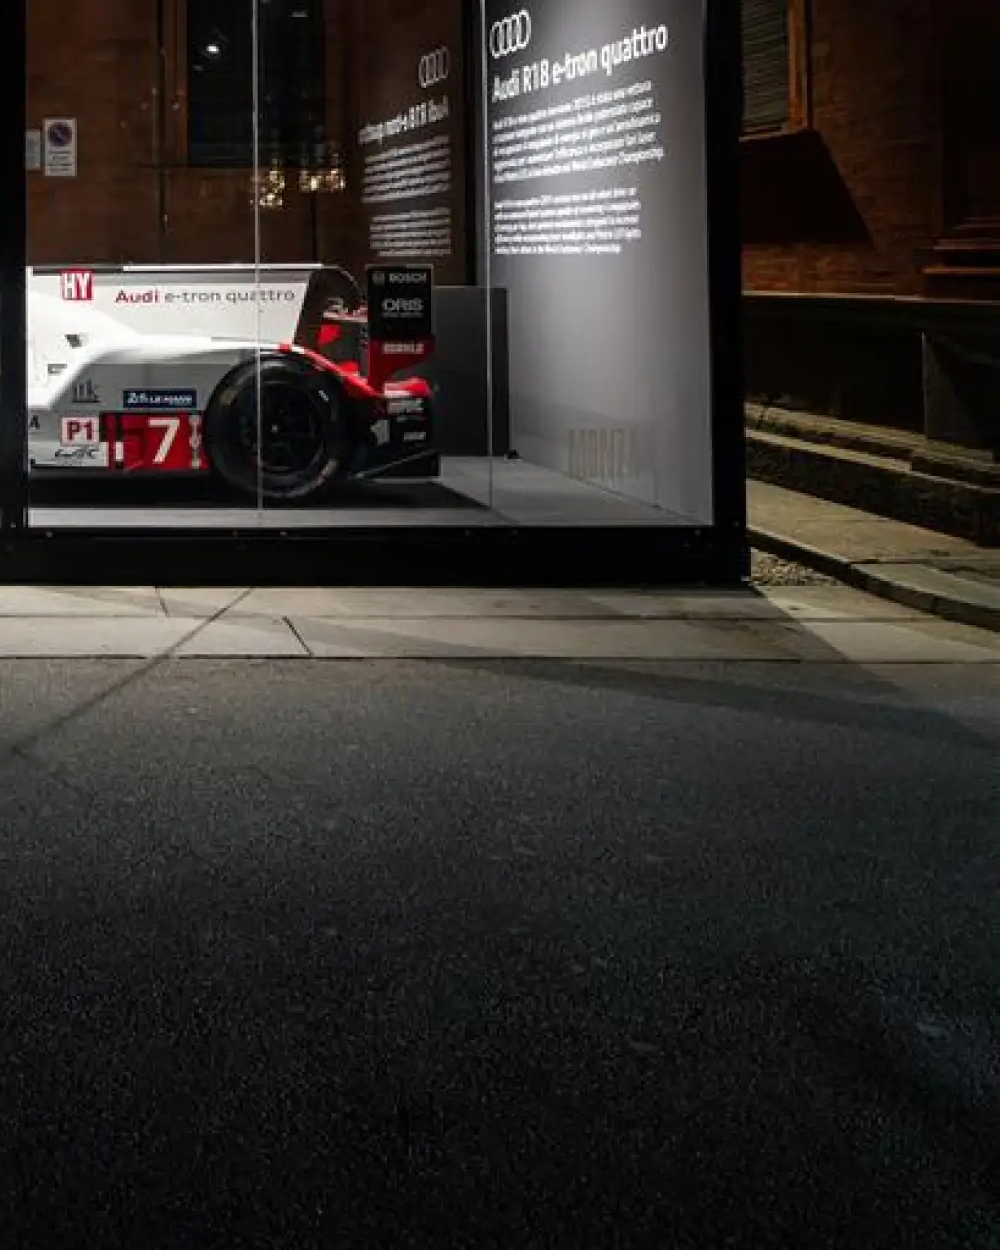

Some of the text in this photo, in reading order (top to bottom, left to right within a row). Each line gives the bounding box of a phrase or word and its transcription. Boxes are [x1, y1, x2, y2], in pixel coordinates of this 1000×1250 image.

[491, 24, 668, 103] Audi R18 e-tron quattro
[63, 273, 91, 299] HY
[115, 289, 296, 304] Audi e-tron quattro
[66, 420, 94, 441] P1
[147, 418, 181, 465] 7
